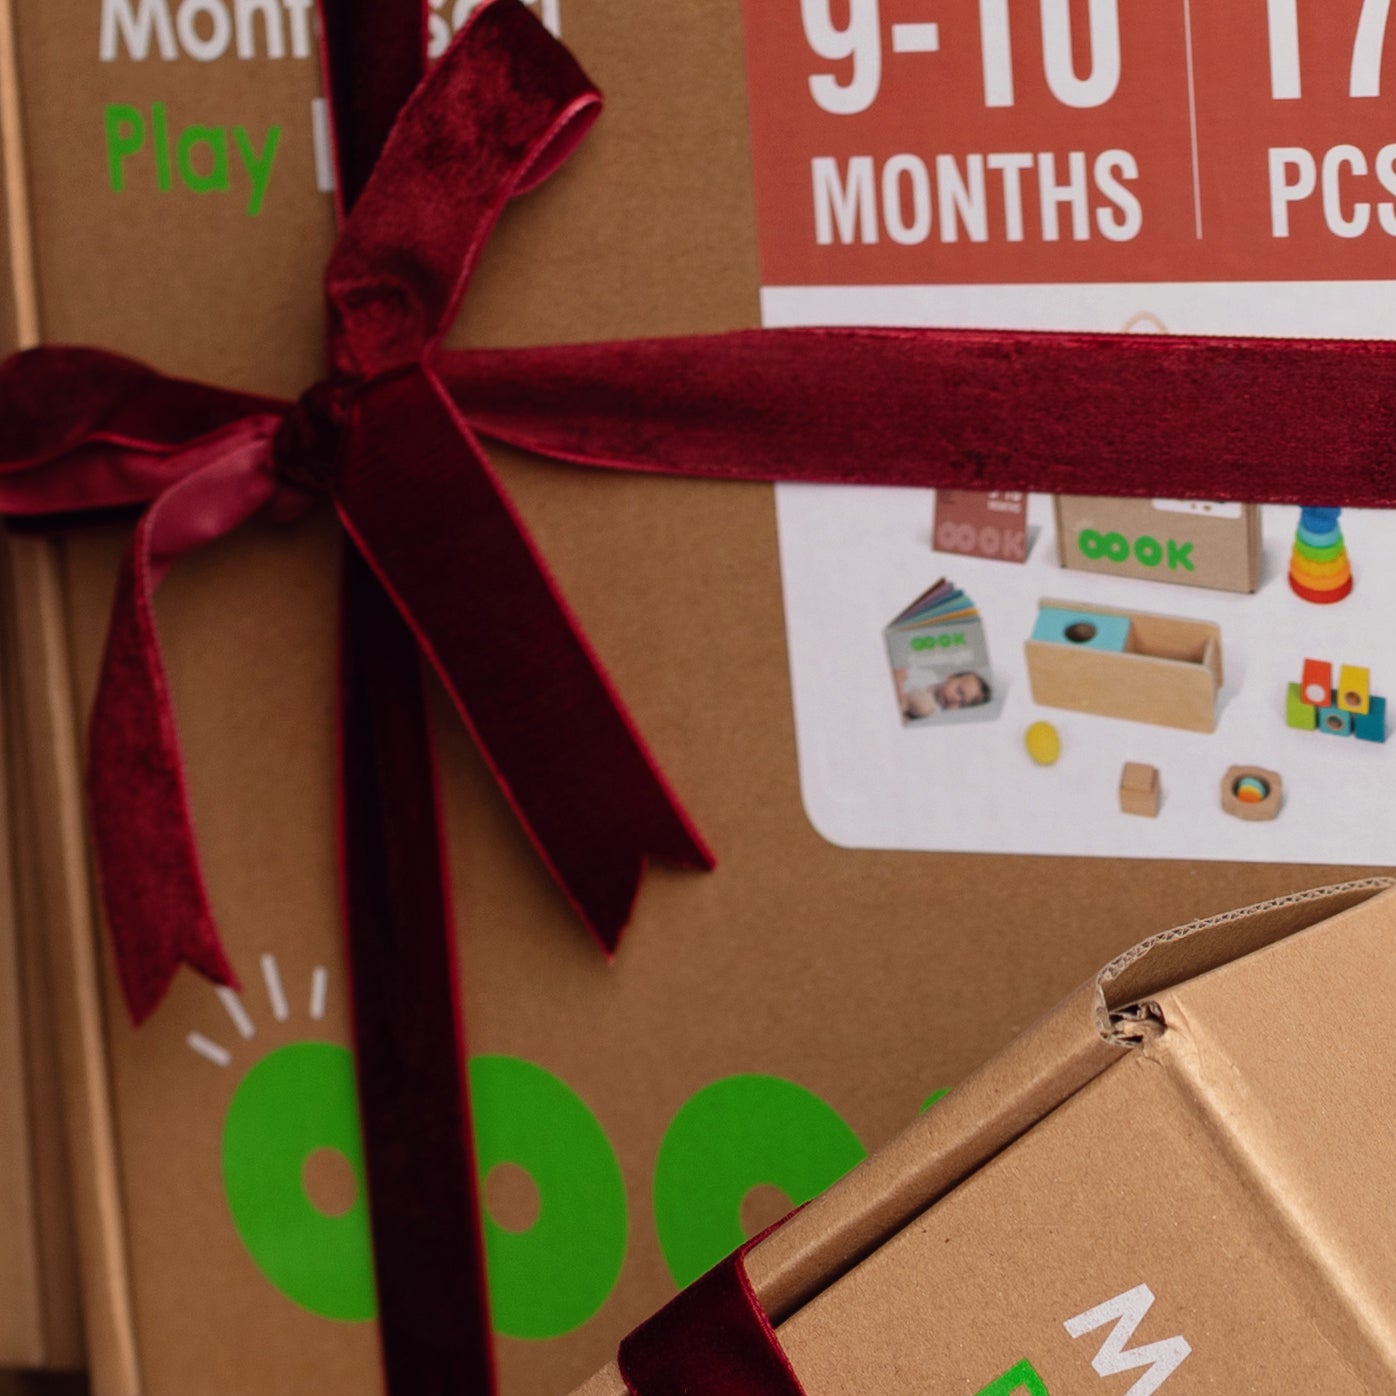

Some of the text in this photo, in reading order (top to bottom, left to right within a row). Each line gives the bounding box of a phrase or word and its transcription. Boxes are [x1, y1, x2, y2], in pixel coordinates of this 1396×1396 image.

[801, 0, 1120, 115] 9-10
[1266, 0, 1392, 100] 17
[106, 103, 280, 214] Play
[812, 148, 1142, 246] MONTHS
